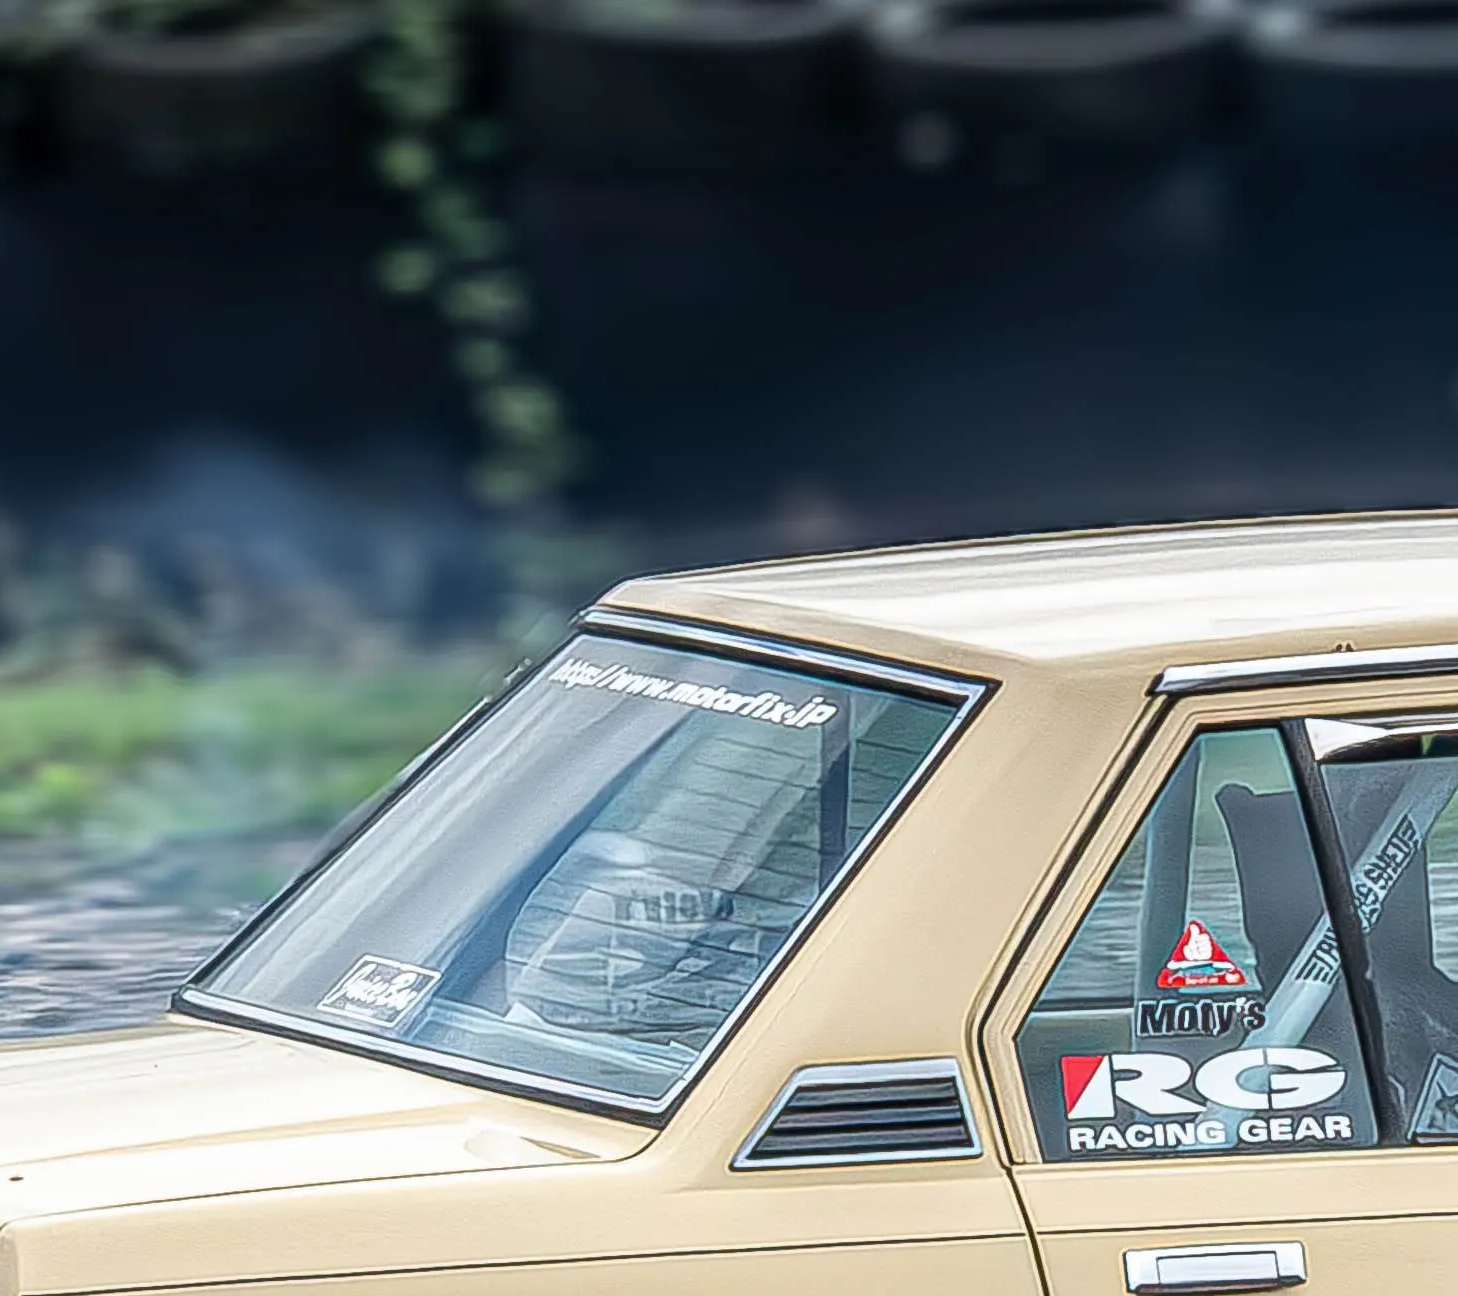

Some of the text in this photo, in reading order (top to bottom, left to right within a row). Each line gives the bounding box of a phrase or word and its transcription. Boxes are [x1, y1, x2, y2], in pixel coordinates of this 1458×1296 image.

[1136, 997, 1267, 1037] Moty's
[1060, 1047, 1346, 1120] RG
[1069, 1115, 1352, 1151] RACING GEAR
